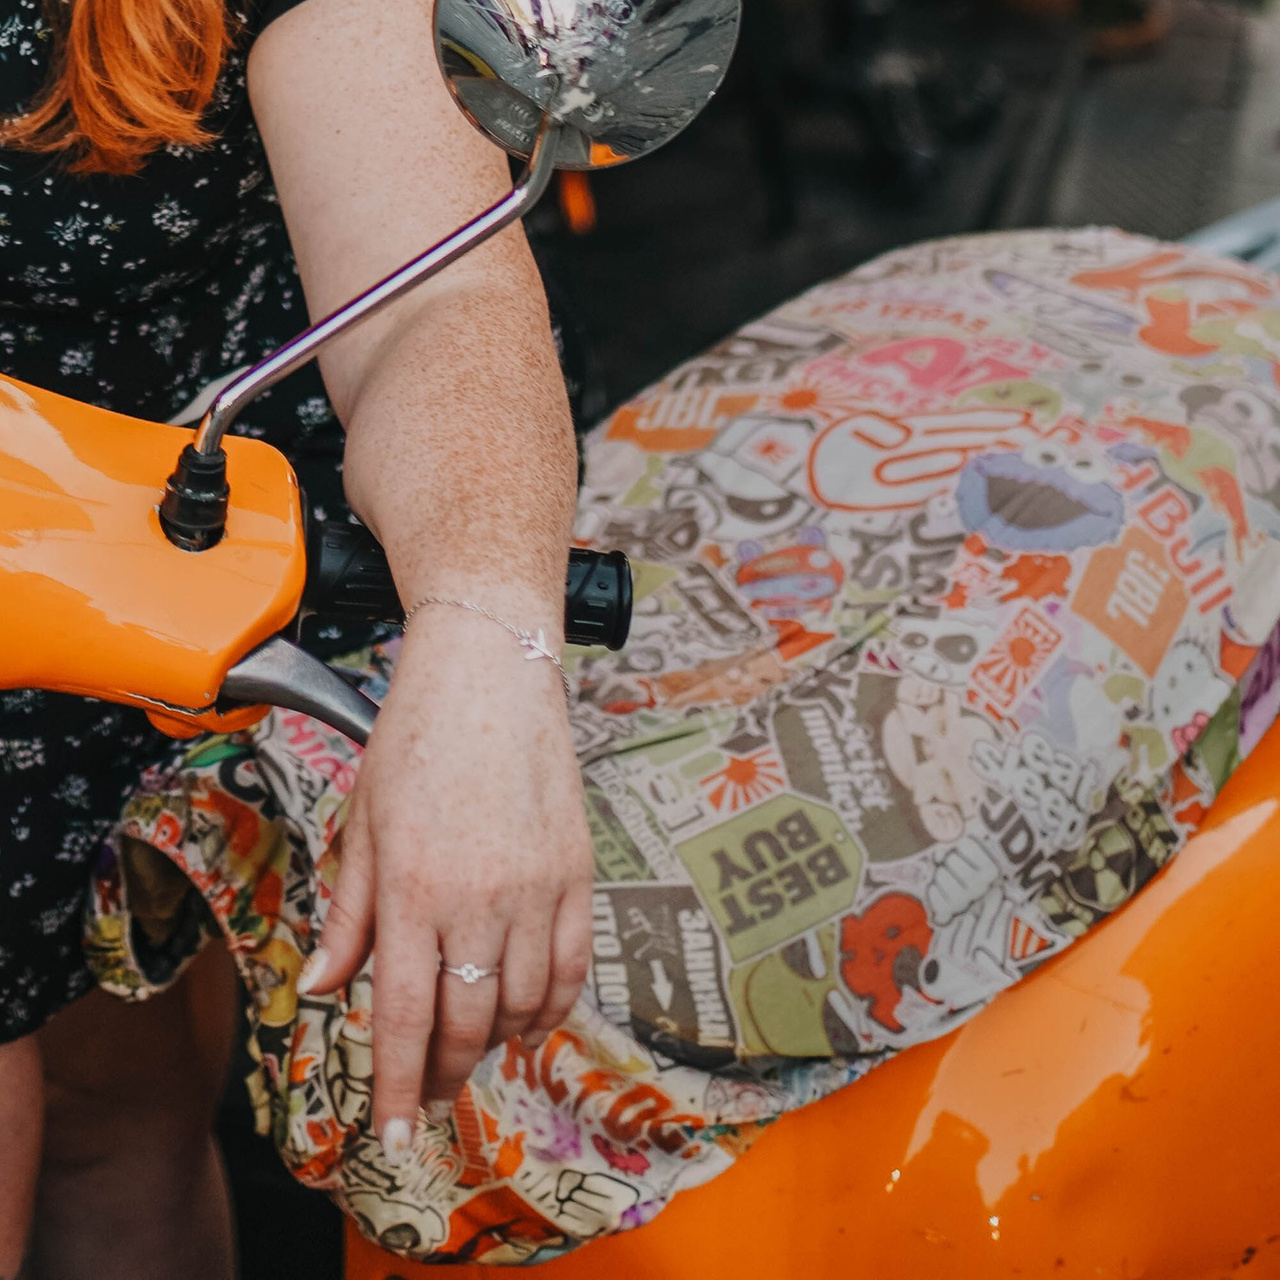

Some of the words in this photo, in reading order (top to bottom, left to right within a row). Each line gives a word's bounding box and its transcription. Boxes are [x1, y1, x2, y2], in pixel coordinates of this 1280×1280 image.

[1138, 488, 1233, 615] Bull
[712, 809, 821, 892] BUY
[721, 843, 850, 936] BEST
